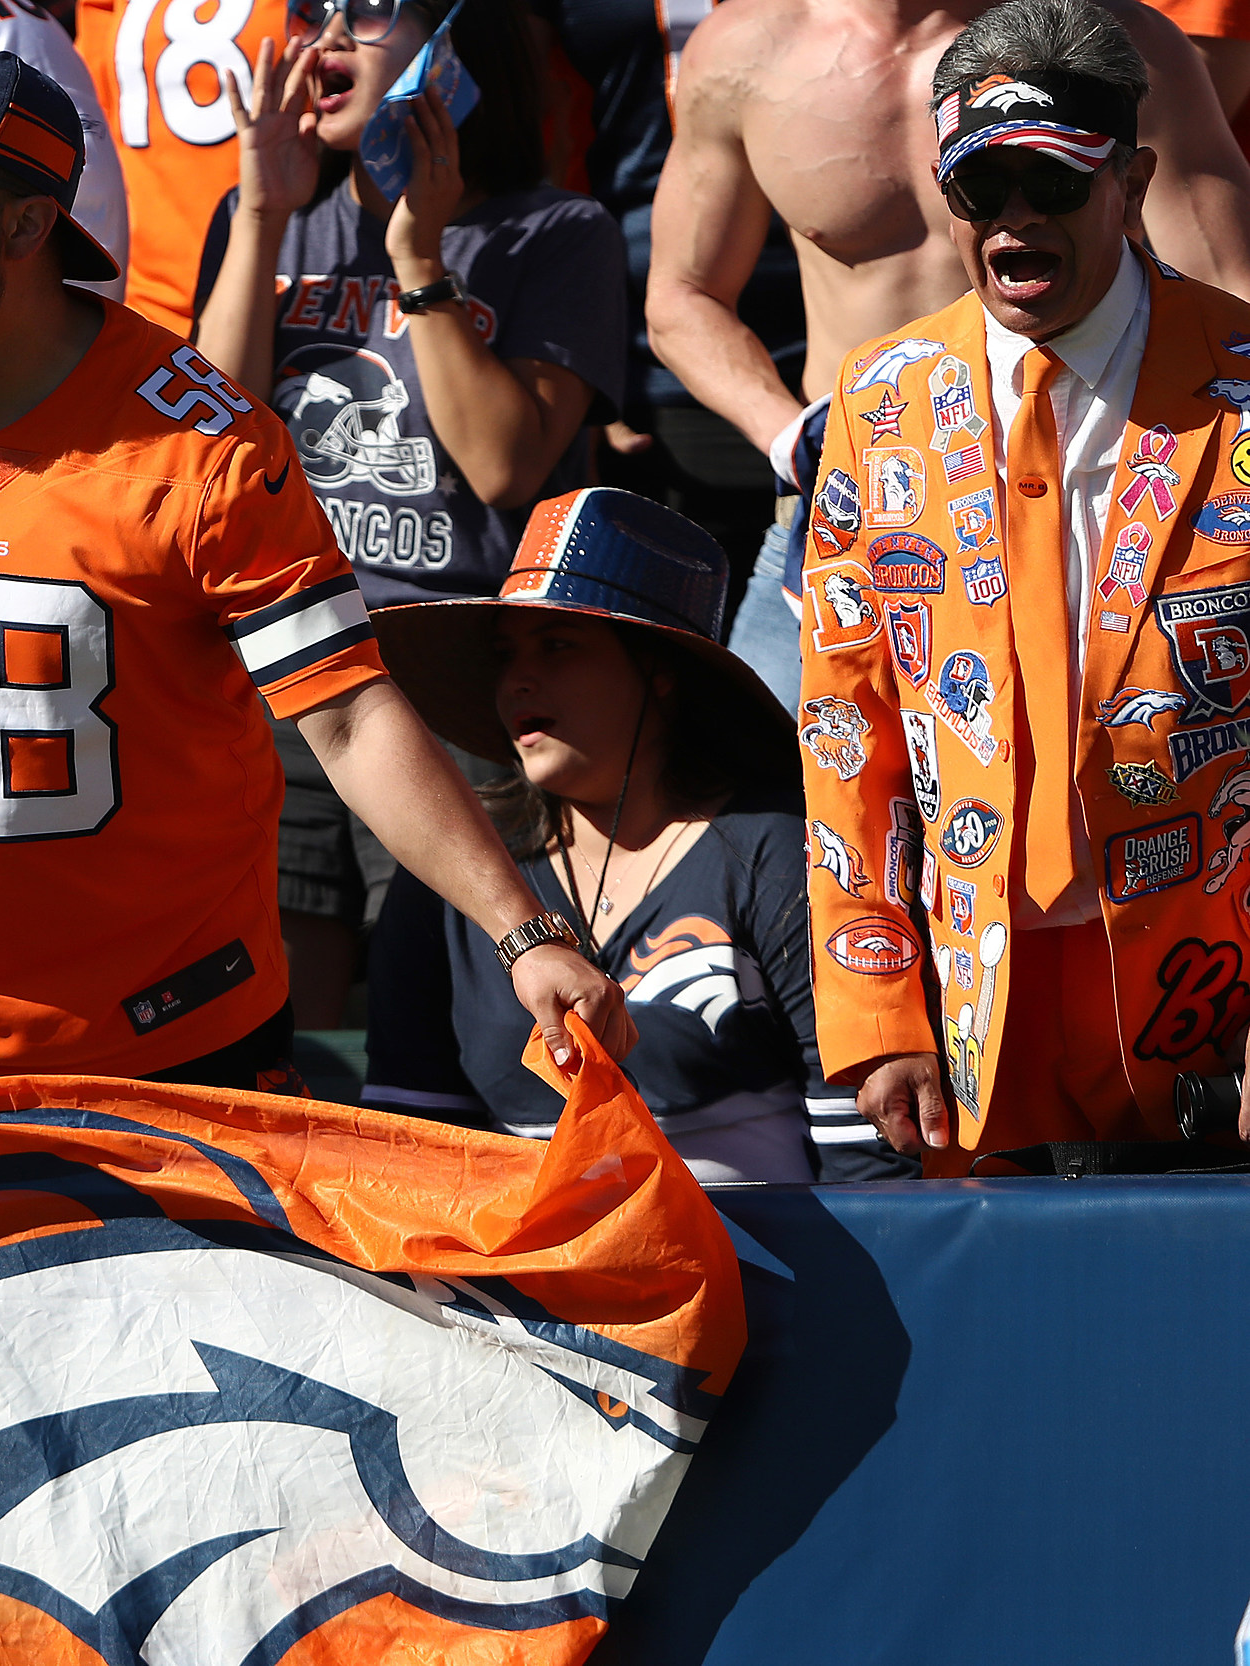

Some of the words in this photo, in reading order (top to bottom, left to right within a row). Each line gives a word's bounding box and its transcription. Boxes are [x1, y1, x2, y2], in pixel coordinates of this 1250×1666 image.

[114, 0, 254, 146] 18
[135, 345, 254, 436] 58
[939, 403, 970, 427] NFL
[1019, 482, 1036, 490] MR.
[952, 490, 990, 509] BRONCOS
[1213, 493, 1250, 510] DENVE
[1213, 528, 1250, 542] BRONC
[874, 562, 941, 589] BRONCOS
[1113, 561, 1137, 581] NFL
[969, 576, 1001, 601] 100
[1170, 592, 1250, 620] BRONCO
[951, 810, 985, 855] 50
[1124, 826, 1189, 861] ORANGE
[888, 836, 899, 898] BRONCOS
[1138, 843, 1191, 876] CRUSH
[1146, 864, 1185, 886] DEFENSE
